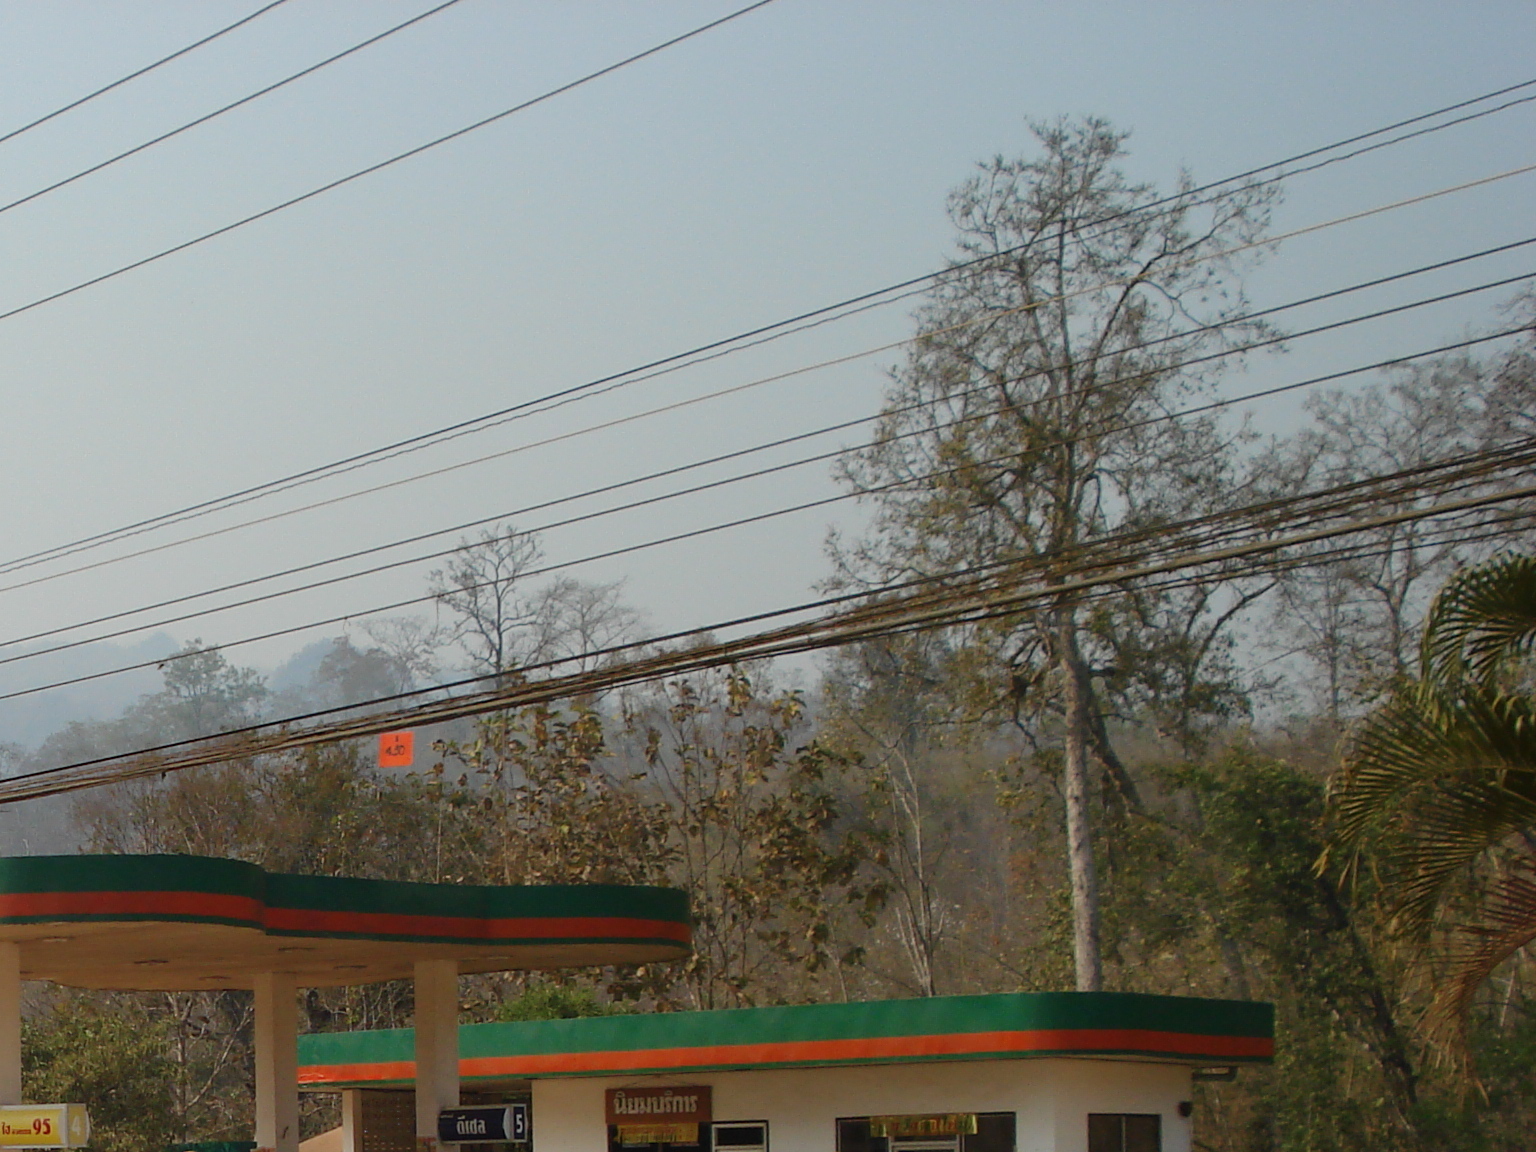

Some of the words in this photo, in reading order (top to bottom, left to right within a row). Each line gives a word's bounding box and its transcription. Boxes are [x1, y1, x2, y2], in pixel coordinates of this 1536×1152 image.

[32, 1118, 51, 1135] 95
[72, 1116, 81, 1136] 4
[516, 1114, 523, 1134] 5
